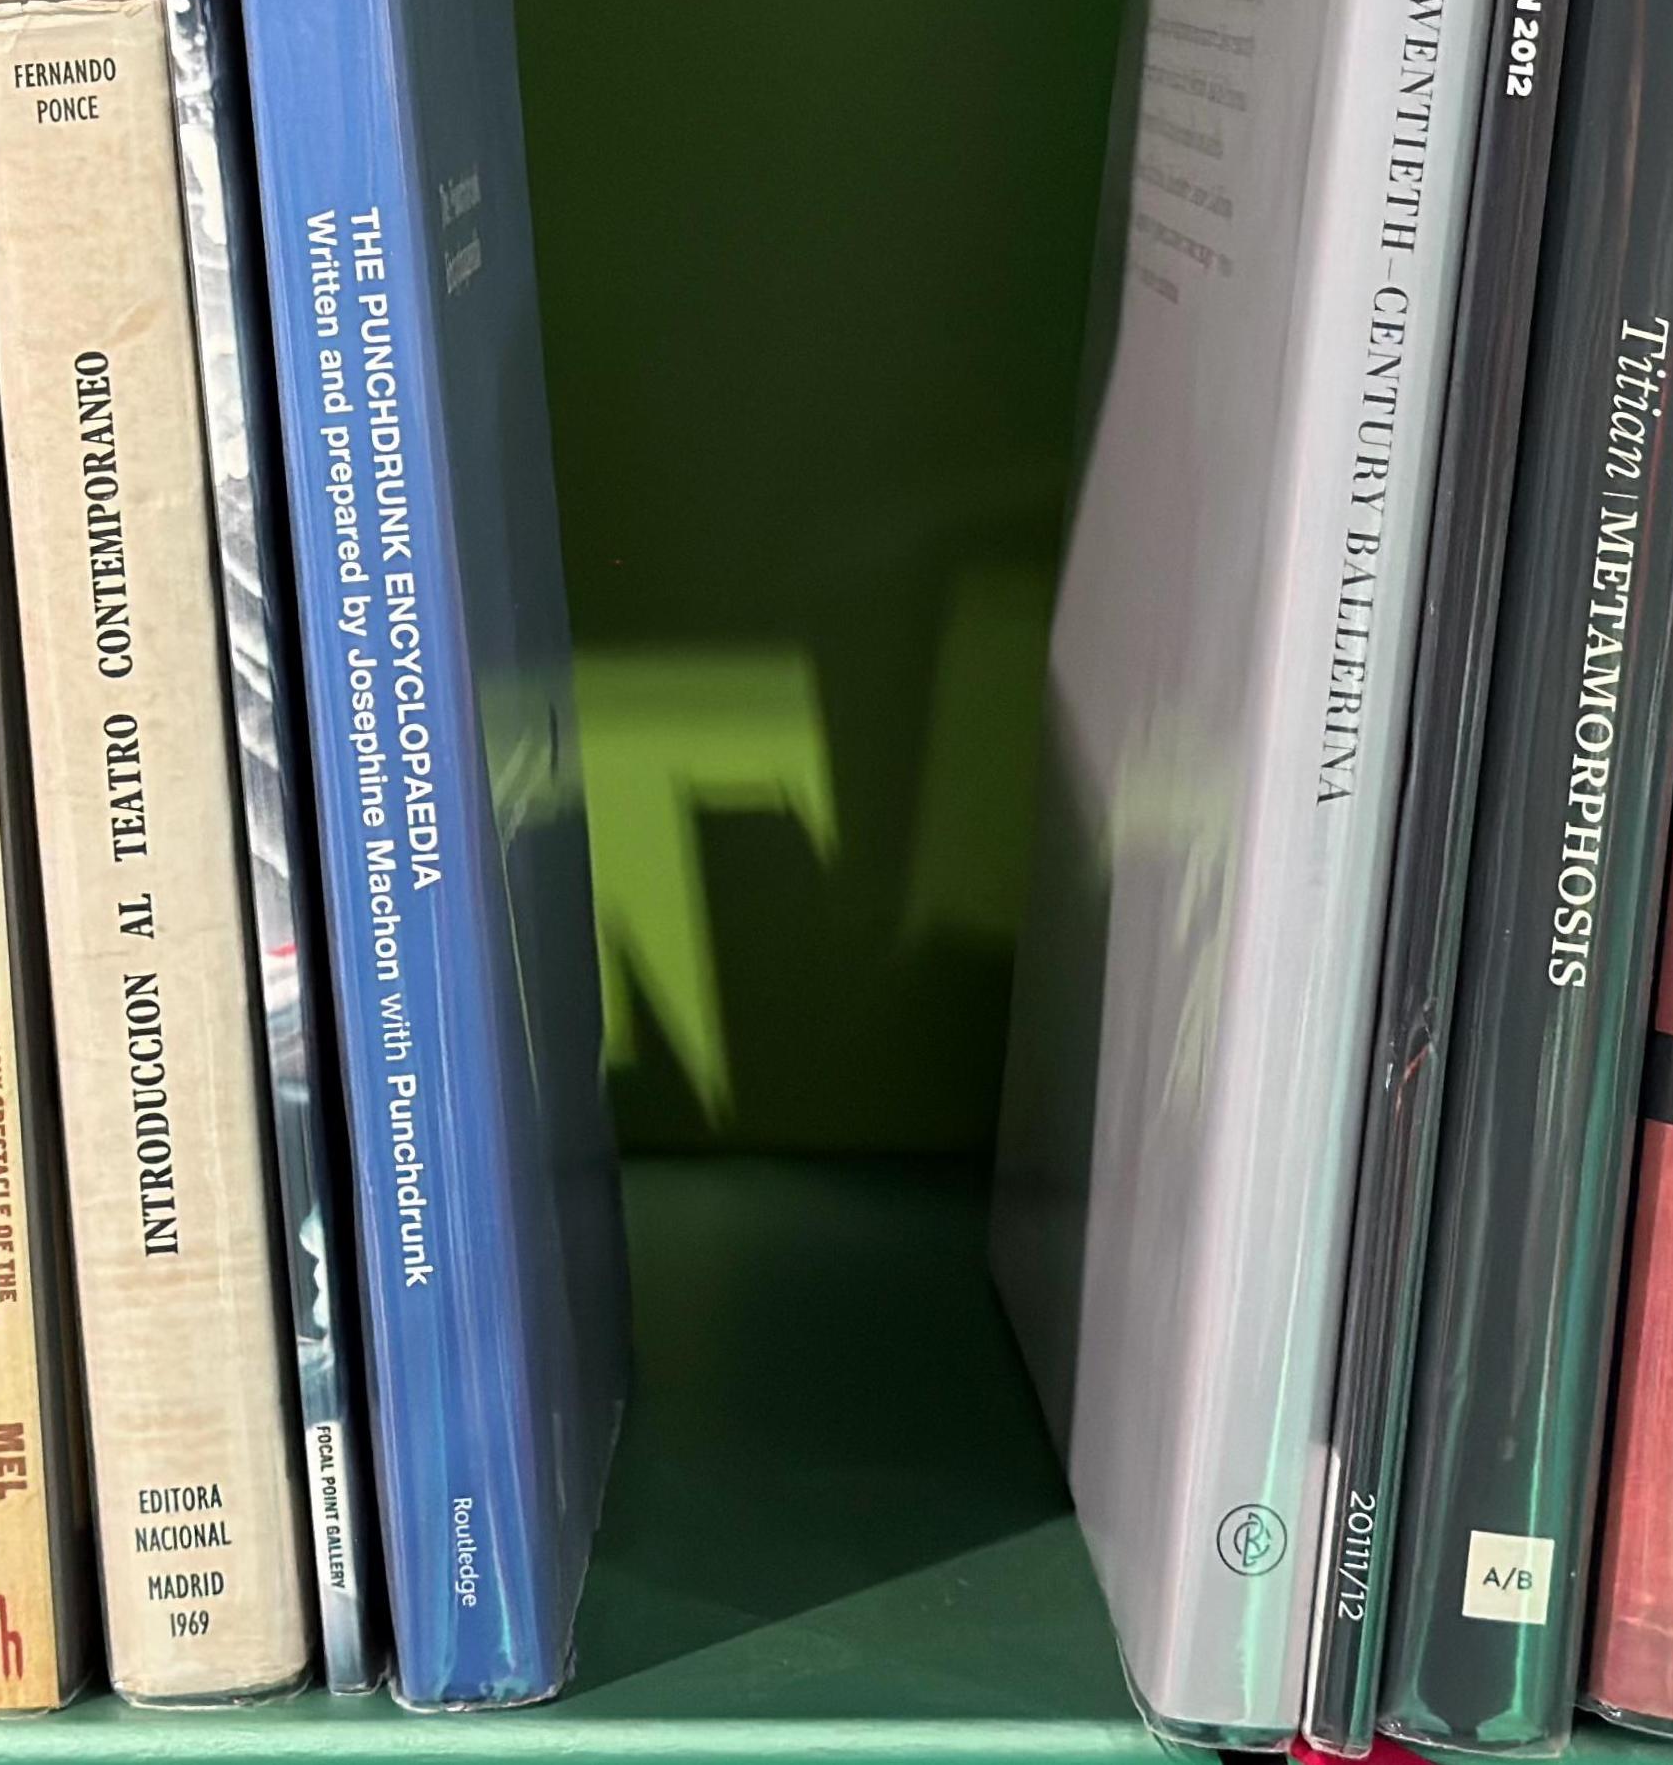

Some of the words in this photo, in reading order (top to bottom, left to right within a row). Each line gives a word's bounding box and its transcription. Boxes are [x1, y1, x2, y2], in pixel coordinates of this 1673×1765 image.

[13, 57, 117, 89] FERNANDO
[1506, 18, 1539, 98] 2012
[36, 95, 100, 123] PONCE
[306, 210, 341, 337] Written
[350, 207, 385, 282] THE
[319, 349, 353, 413] and
[1605, 317, 1670, 481] Titian
[359, 294, 412, 562] PUNCHDRUNK
[73, 350, 134, 679] CONTEMPORANEO
[324, 426, 369, 583] prepared
[339, 595, 371, 637] by
[1315, 528, 1383, 807] BALLERINA
[348, 649, 389, 828] Josephine
[385, 573, 442, 891] ENCYCLOPAEDIA
[1548, 507, 1638, 987] METAMORPHOSIS
[103, 713, 149, 863] TEATRO
[119, 893, 155, 939] AL
[365, 841, 401, 981] Machon
[380, 993, 412, 1061] with
[123, 971, 179, 1259] INTRODUCCION
[386, 1075, 434, 1287] Punchdrunk
[317, 1426, 334, 1472] FOCAL
[135, 1519, 232, 1553] NACIONAL
[138, 1484, 223, 1514] EDITORA
[321, 1477, 339, 1520] POINT
[148, 1574, 225, 1600] MADRID
[326, 1526, 345, 1588] GALLERY
[453, 1496, 476, 1608] Routledge
[1338, 1491, 1376, 1622] 2011/12
[1483, 1566, 1534, 1590] A/B
[169, 1611, 209, 1637] 1969
